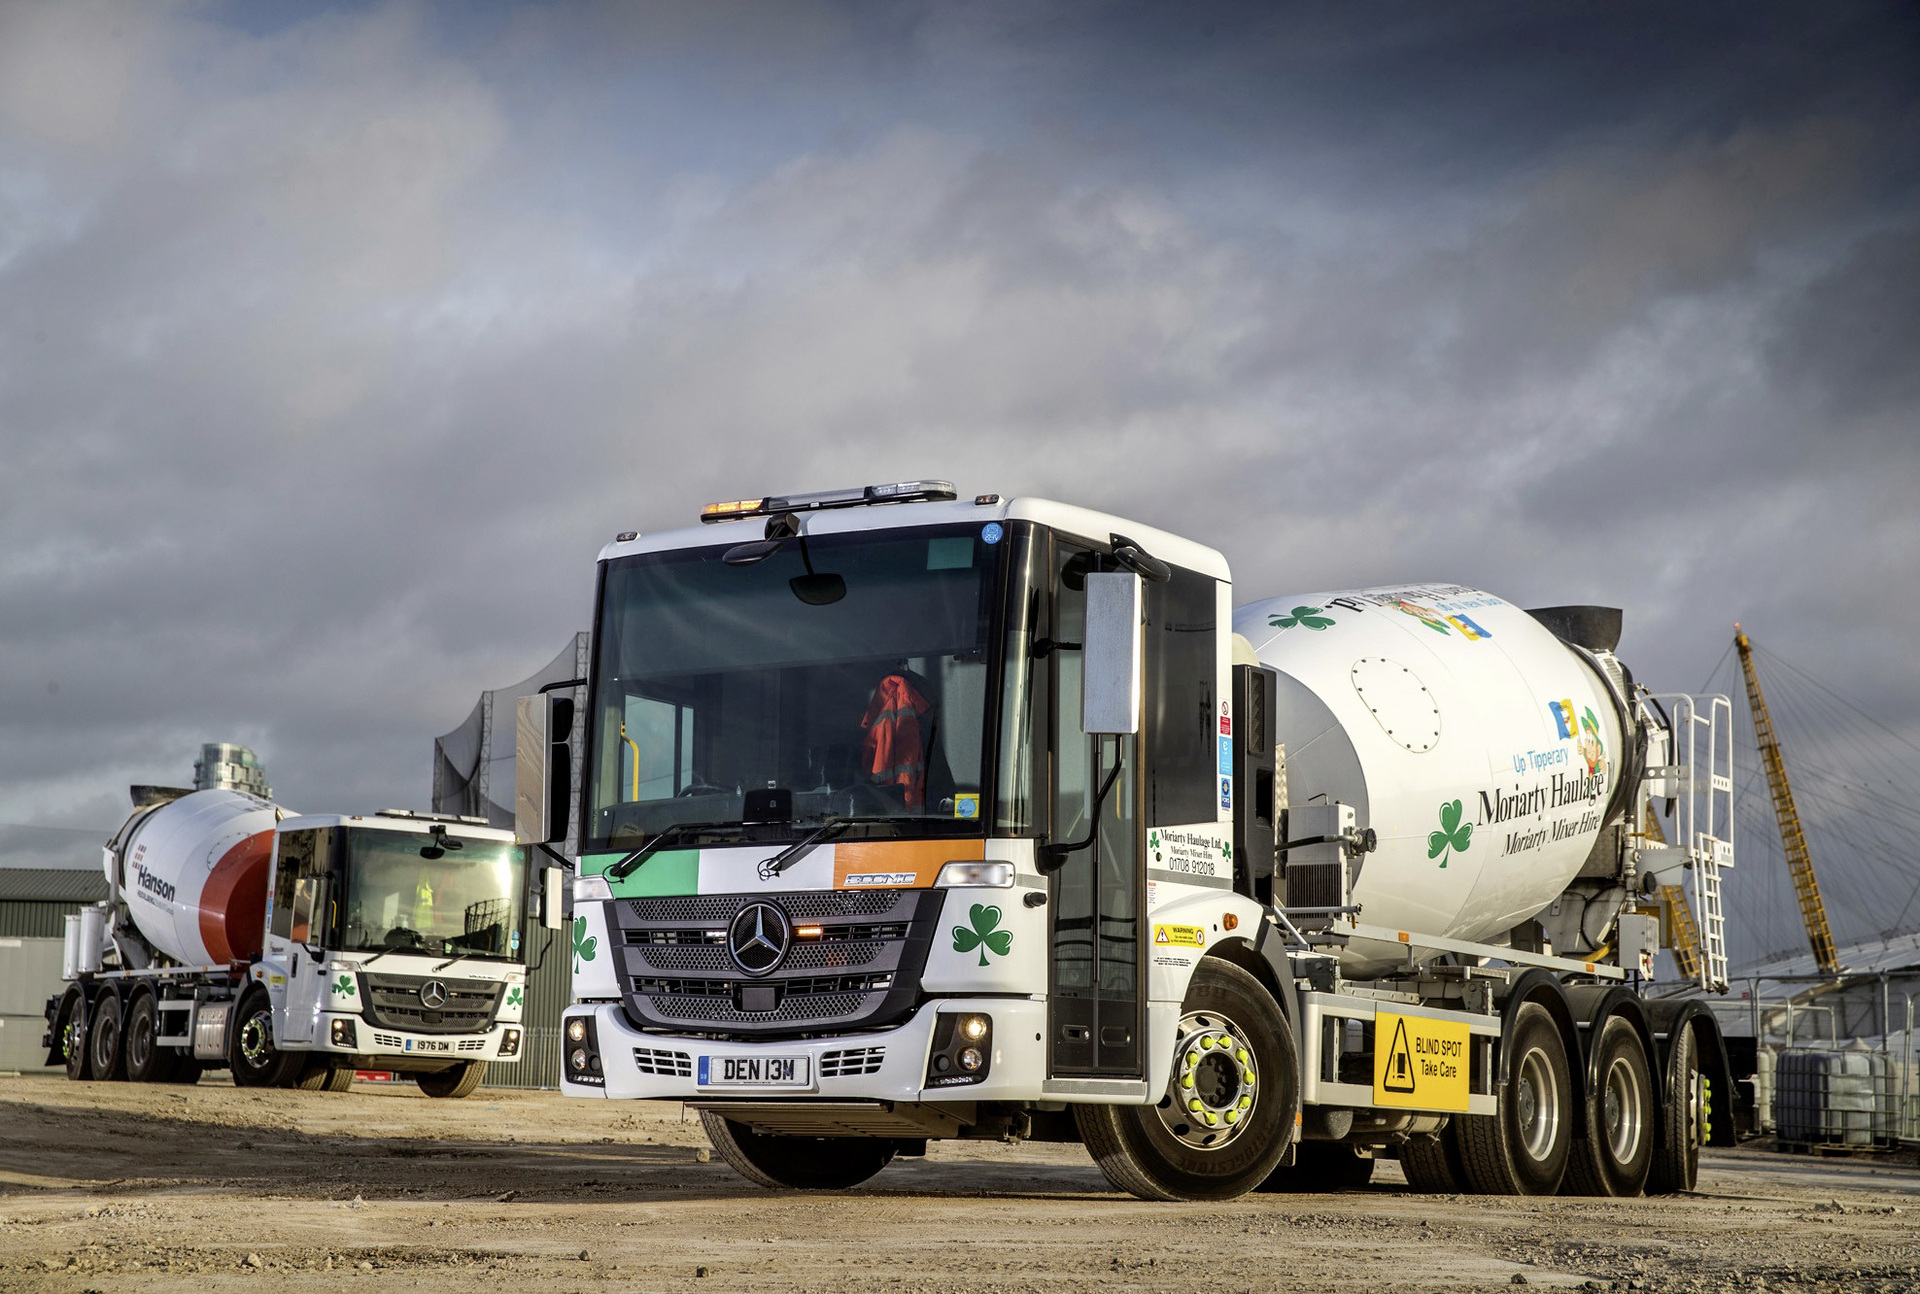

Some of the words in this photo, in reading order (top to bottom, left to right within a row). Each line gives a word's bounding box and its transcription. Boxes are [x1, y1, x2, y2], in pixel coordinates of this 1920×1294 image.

[1513, 755, 1526, 776] Up
[1527, 748, 1569, 773] Tipperary
[1476, 783, 1548, 827] Moriarty
[1550, 768, 1604, 807] Haulage
[1160, 829, 1186, 847] Moriarty
[1187, 833, 1211, 851] Haulage
[1211, 837, 1223, 850] Ltd.
[1501, 828, 1549, 858] Moriarty
[1549, 818, 1579, 843] Mixer
[1578, 810, 1601, 834] Hire
[1170, 846, 1189, 859] Moriarty
[1190, 848, 1203, 858] Mixer
[1203, 850, 1213, 860] Hire
[1169, 857, 1190, 873] 01708
[1191, 860, 1215, 876] 912018
[138, 865, 176, 903] Hanson
[1172, 927, 1194, 935] WARNING
[417, 1041, 437, 1051] 1976
[438, 1042, 449, 1051] DM
[1416, 1037, 1440, 1055] BLIND
[1441, 1040, 1462, 1057] SPOT
[724, 1059, 760, 1080] DEN
[765, 1059, 795, 1080] 13M
[1420, 1059, 1438, 1077] Take
[1439, 1060, 1457, 1078] Care
